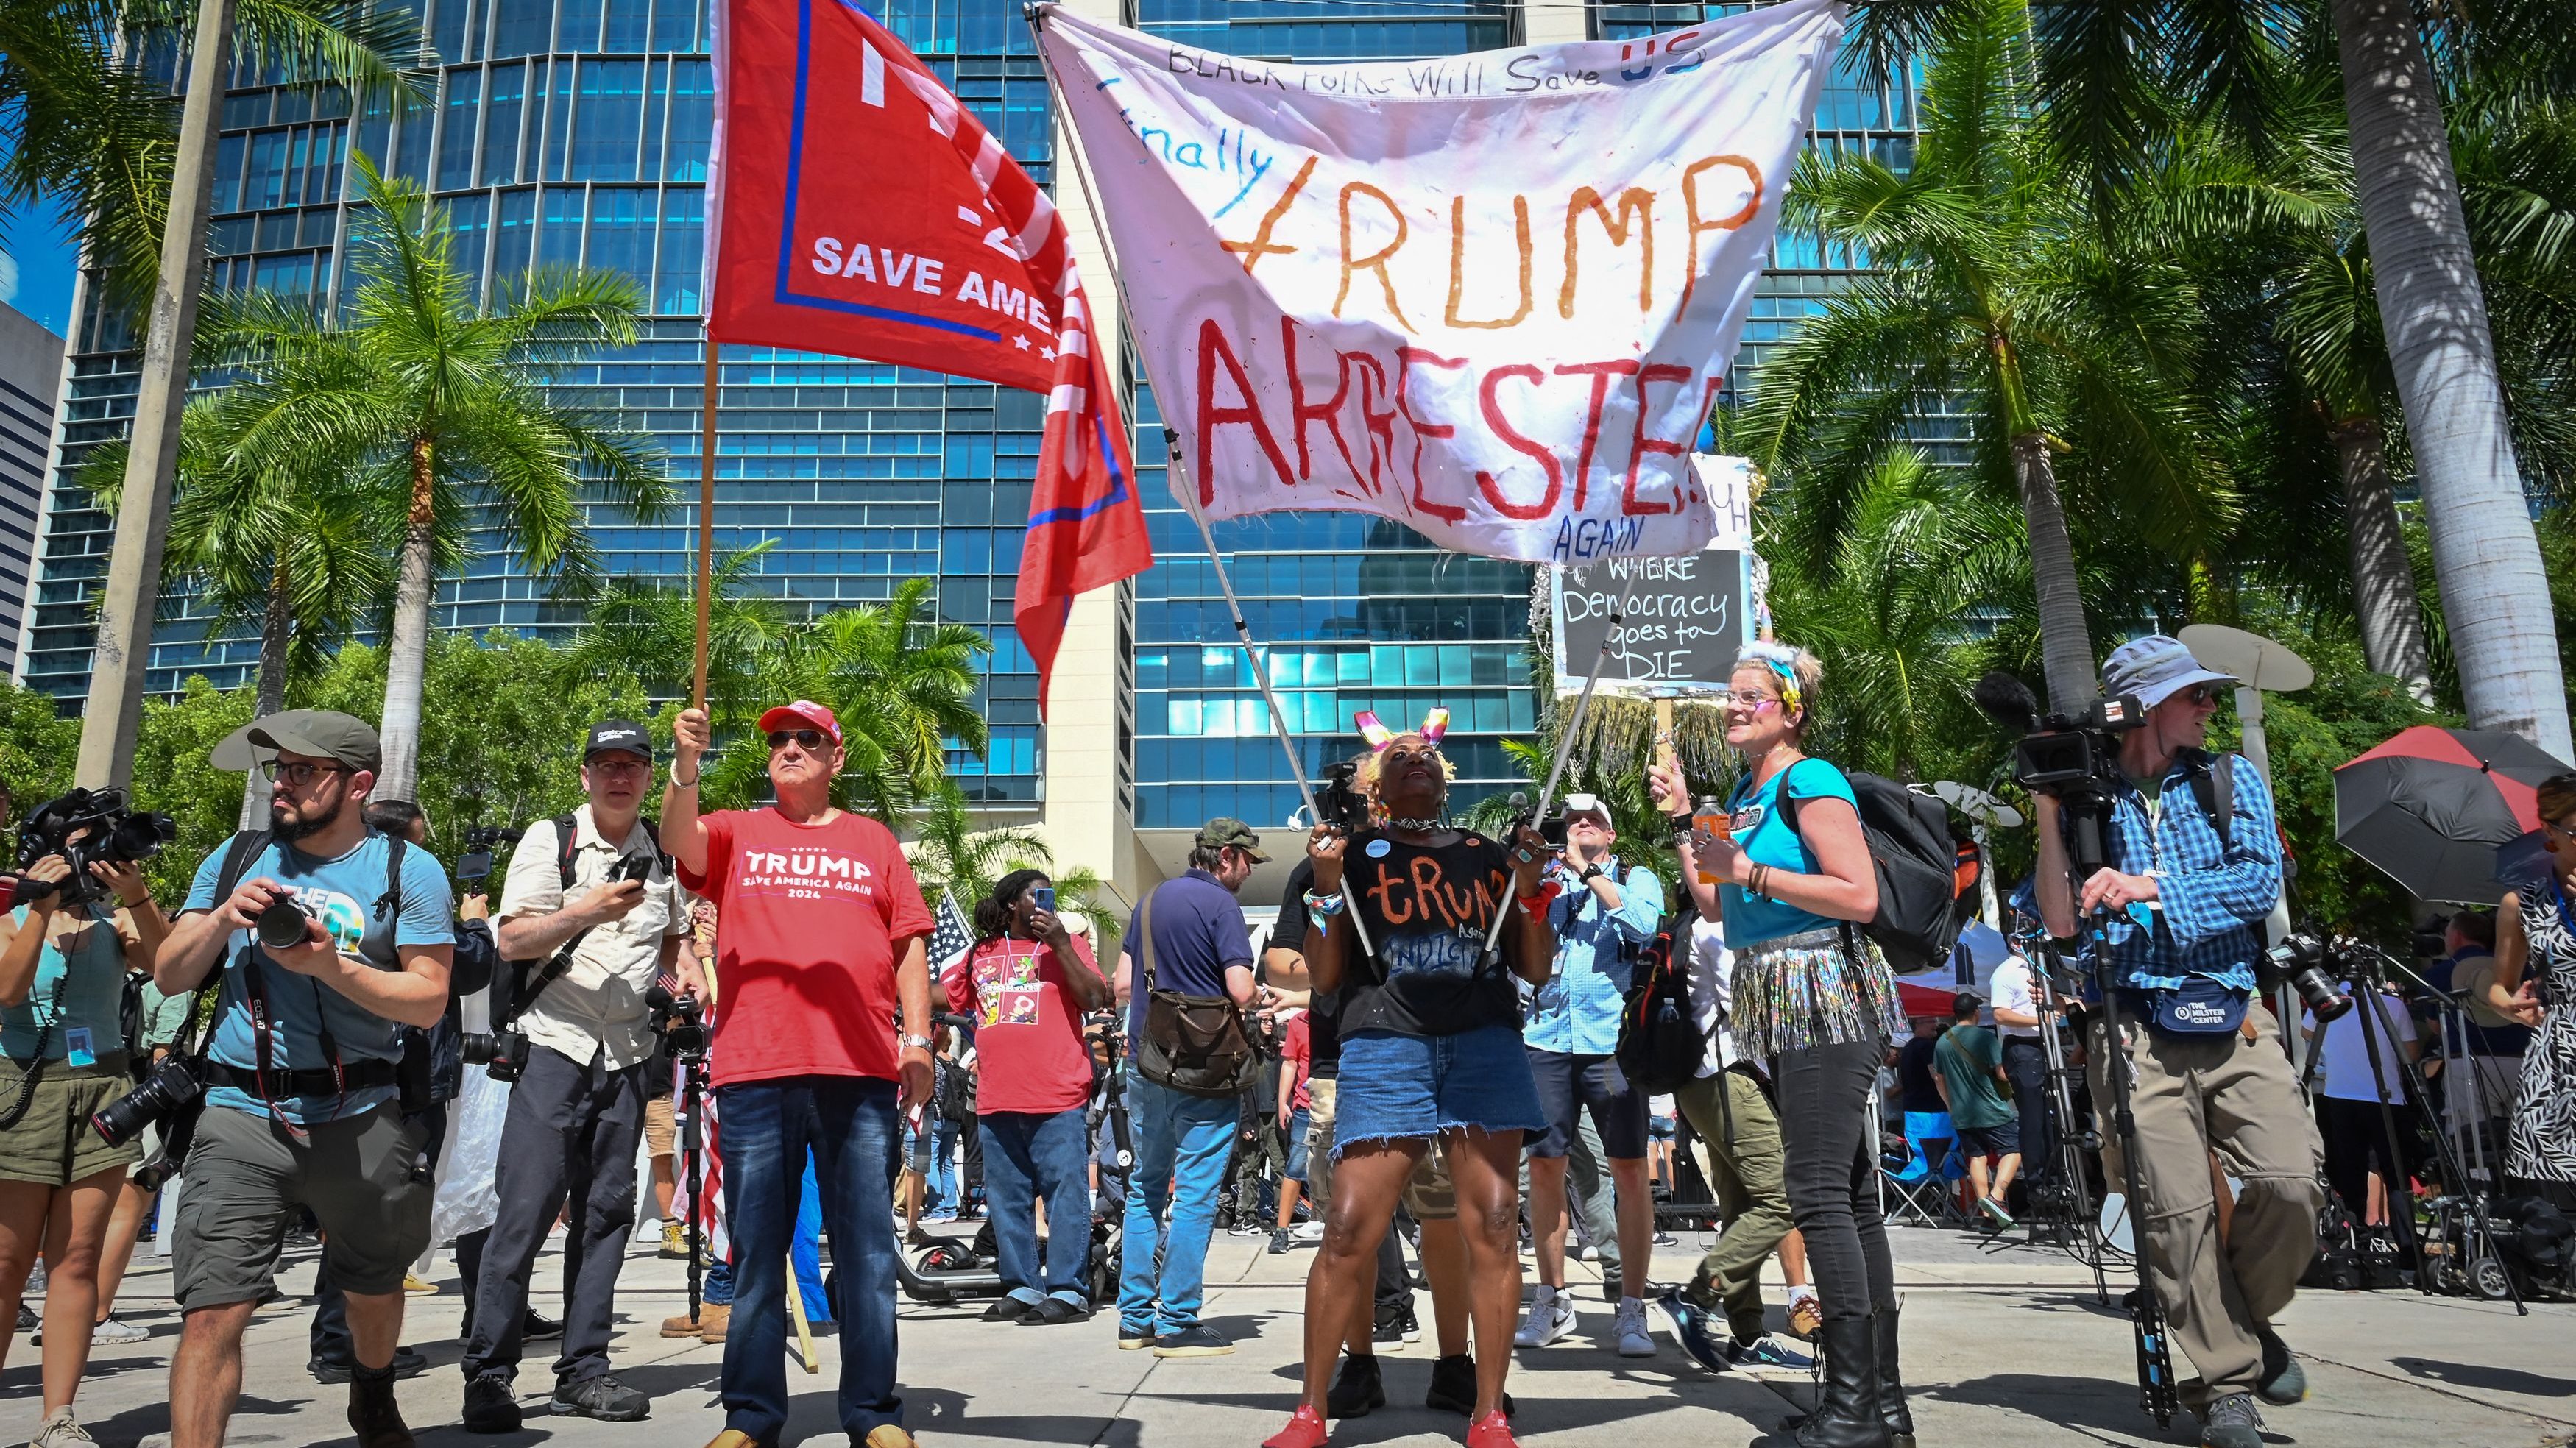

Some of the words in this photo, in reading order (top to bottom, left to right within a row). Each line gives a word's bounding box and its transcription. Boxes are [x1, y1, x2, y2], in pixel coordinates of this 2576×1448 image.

[1406, 61, 1483, 99] Will
[1505, 55, 1601, 93] Save
[1620, 32, 1708, 82] US
[1096, 77, 1273, 219] nally
[811, 236, 944, 297] SAVE
[955, 270, 1060, 341] AME
[1553, 515, 1645, 561] AGAIN
[1608, 556, 1699, 582] WHERE
[1562, 589, 1728, 637] Democracy
[1610, 624, 1668, 659] goes
[1674, 620, 1701, 646] to
[1625, 650, 1694, 681] DIE
[745, 850, 871, 881] TRUMP
[742, 875, 771, 887] SAVE
[774, 876, 831, 889] AMERICA
[835, 881, 872, 896] AGAIN
[787, 888, 822, 900] 2024
[253, 998, 264, 1020] EOS
[2189, 1001, 2207, 1009] THE
[2192, 1008, 2226, 1017] MILSTEIN
[2193, 1016, 2223, 1024] CENTER
